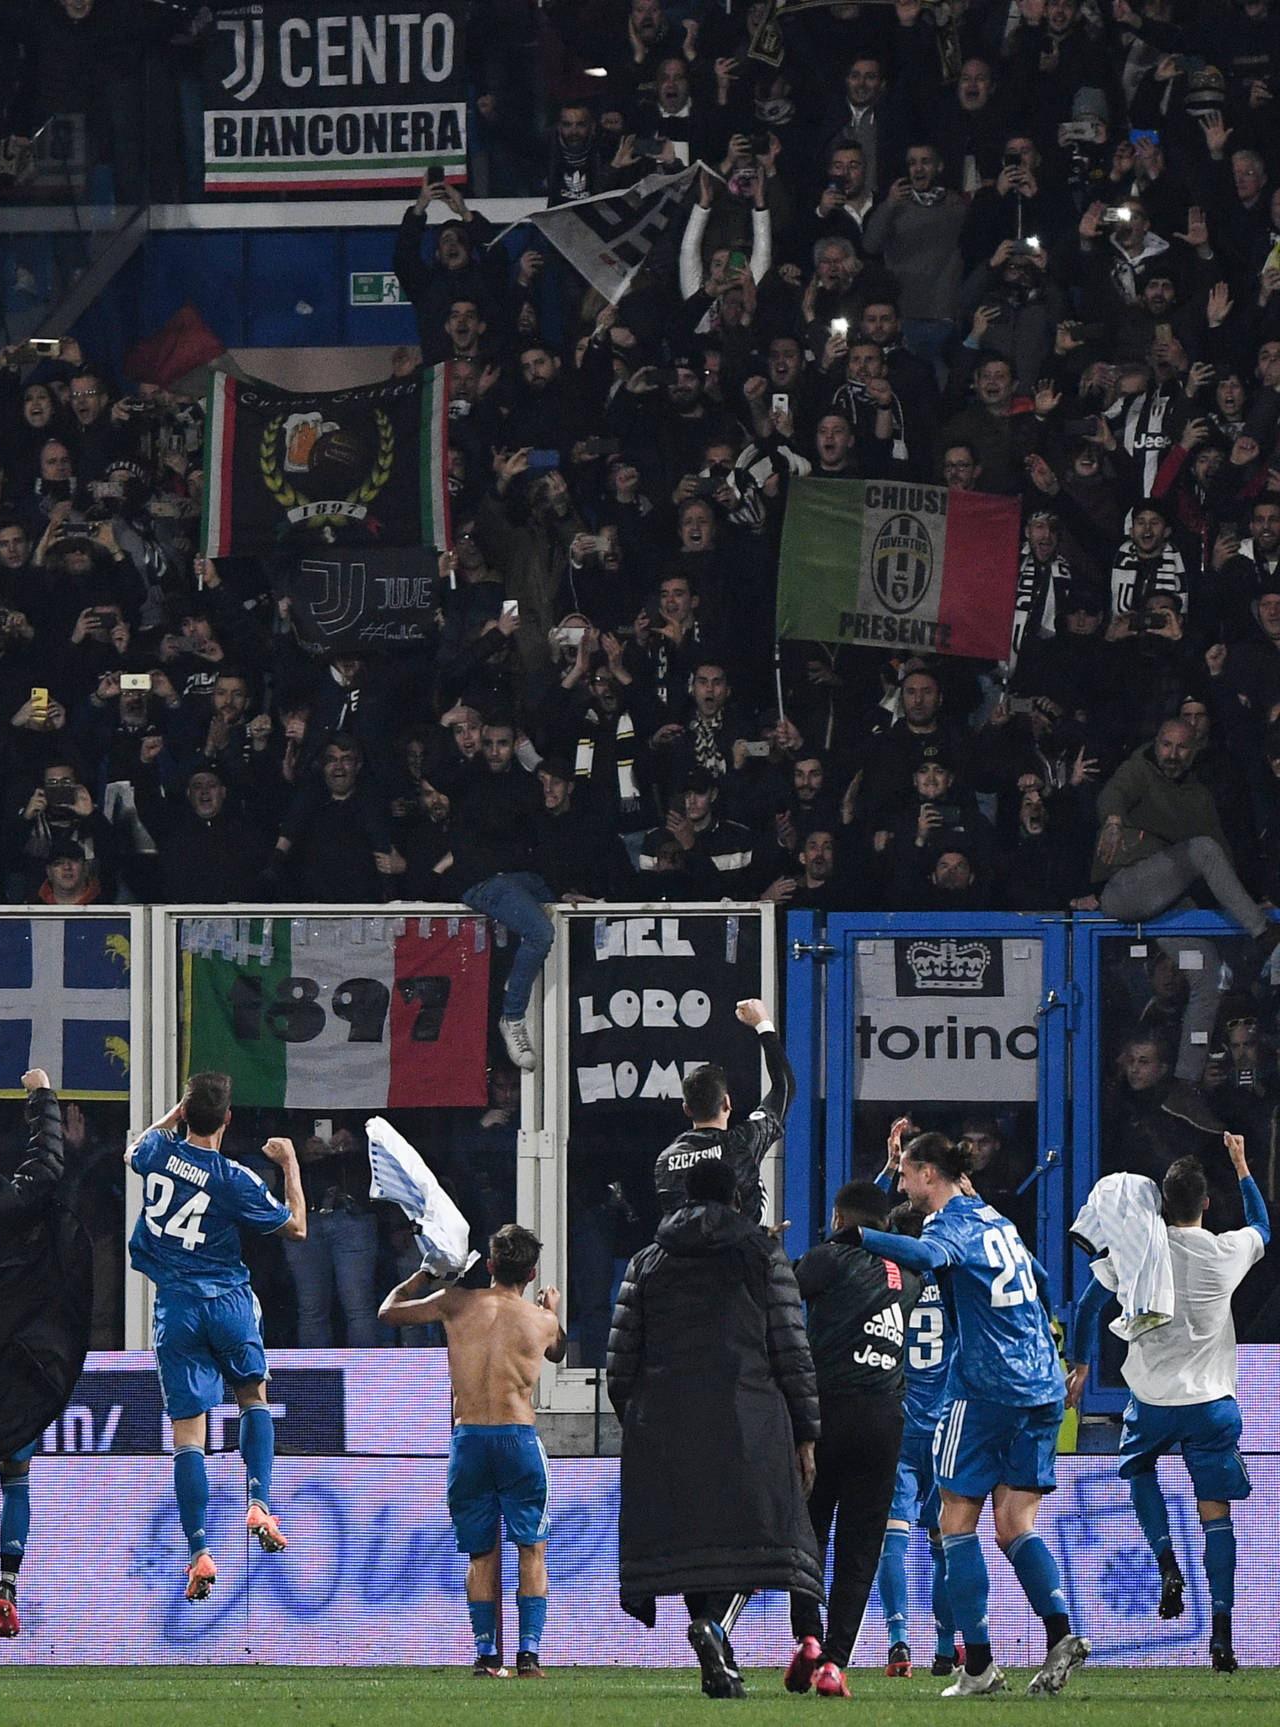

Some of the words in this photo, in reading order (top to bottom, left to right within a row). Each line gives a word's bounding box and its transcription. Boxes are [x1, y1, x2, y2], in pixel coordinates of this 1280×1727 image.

[279, 12, 455, 88] CENTO
[213, 109, 462, 157] BIANCONERA
[302, 502, 359, 517] 1897
[865, 485, 950, 516] CHIUSI
[879, 536, 929, 555] JUVENTUS
[839, 612, 952, 649] PRESENTE
[230, 975, 452, 1043] 1897
[578, 989, 712, 1034] LORO
[856, 1015, 1039, 1060] torino
[165, 1154, 210, 1188] RUGANI
[144, 1172, 212, 1252] 24
[982, 1224, 1038, 1308] 25
[863, 1320, 904, 1348] adida
